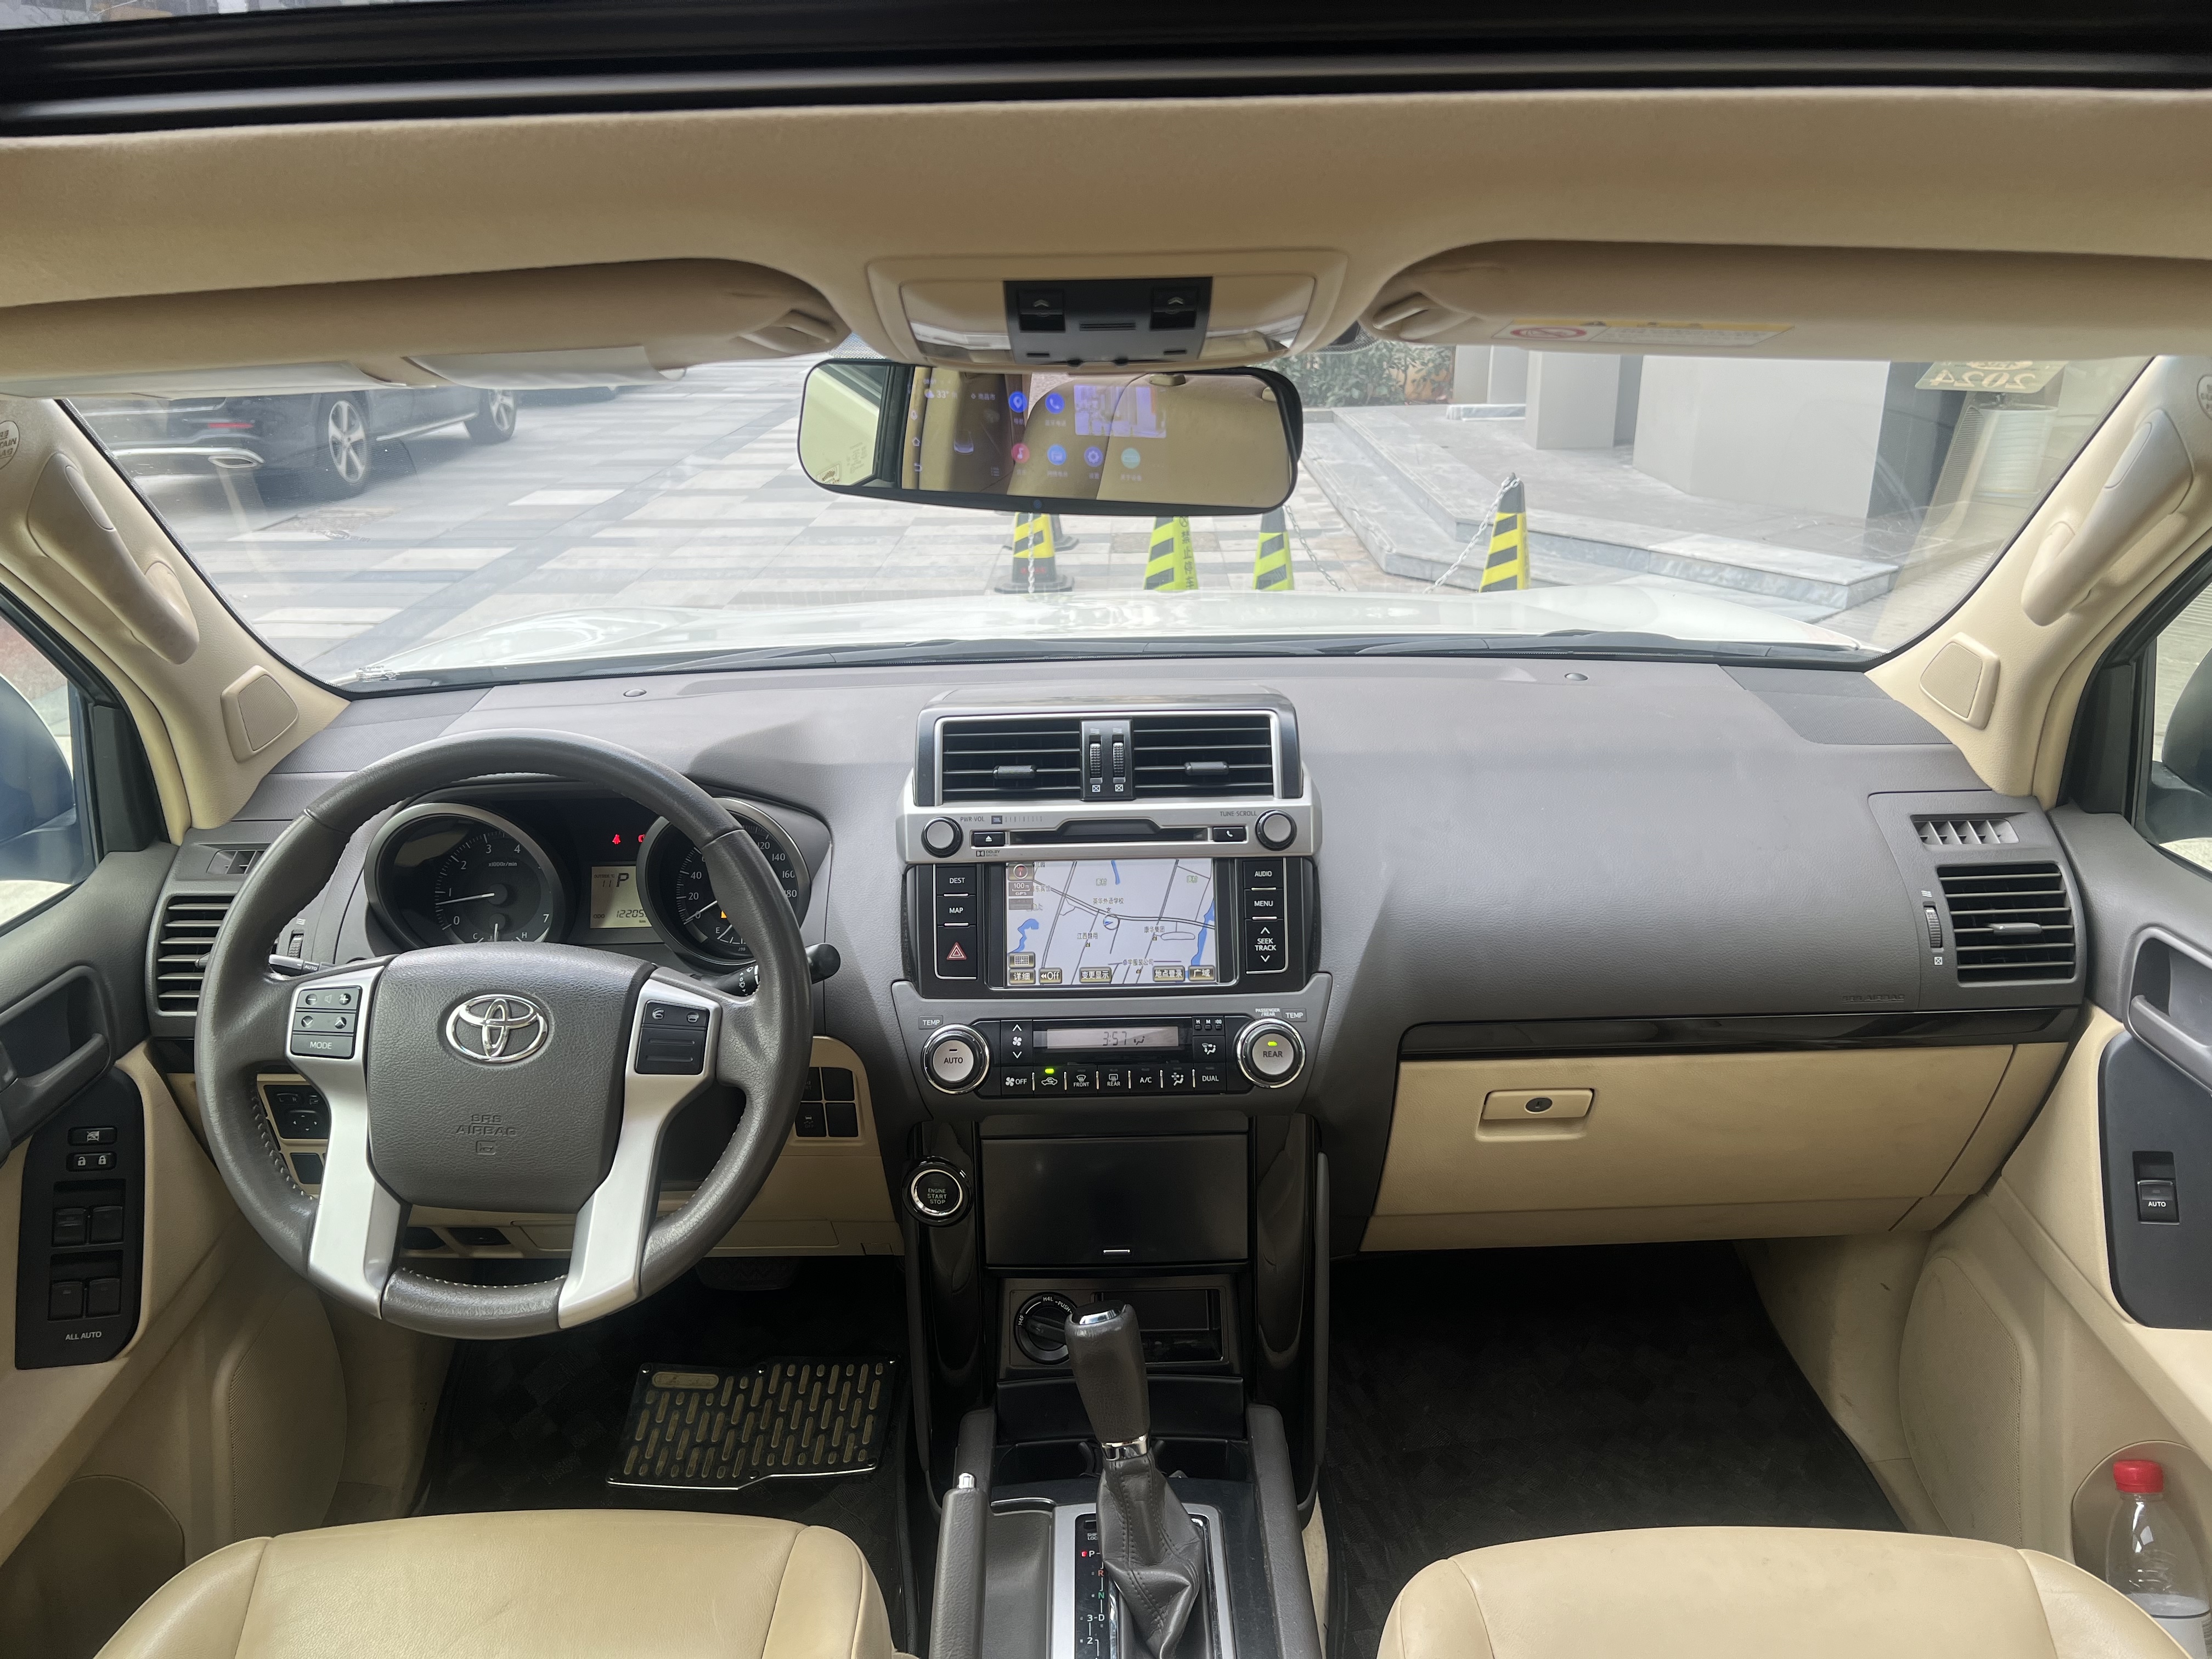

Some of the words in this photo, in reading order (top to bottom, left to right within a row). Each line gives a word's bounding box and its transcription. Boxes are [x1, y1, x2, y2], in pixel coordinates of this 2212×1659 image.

[1181, 531, 1194, 590] 禁止停车
[486, 845, 492, 854] 3
[514, 844, 521, 853] 4
[772, 853, 786, 861] 140
[461, 861, 466, 870] 2
[691, 871, 702, 879] 40
[616, 873, 629, 887] P
[616, 909, 647, 918] 12205
[454, 916, 460, 925] 0
[543, 914, 549, 923] 7
[1013, 972, 1030, 980] 详细
[1082, 971, 1109, 979] 变更显示
[1155, 969, 1183, 978] 地点登录
[1193, 969, 1210, 977] 广域
[1102, 1031, 1127, 1046] 3:57
[309, 1041, 332, 1049] MODE
[456, 1125, 517, 1136] AIRBAG
[65, 1332, 80, 1340] ALL
